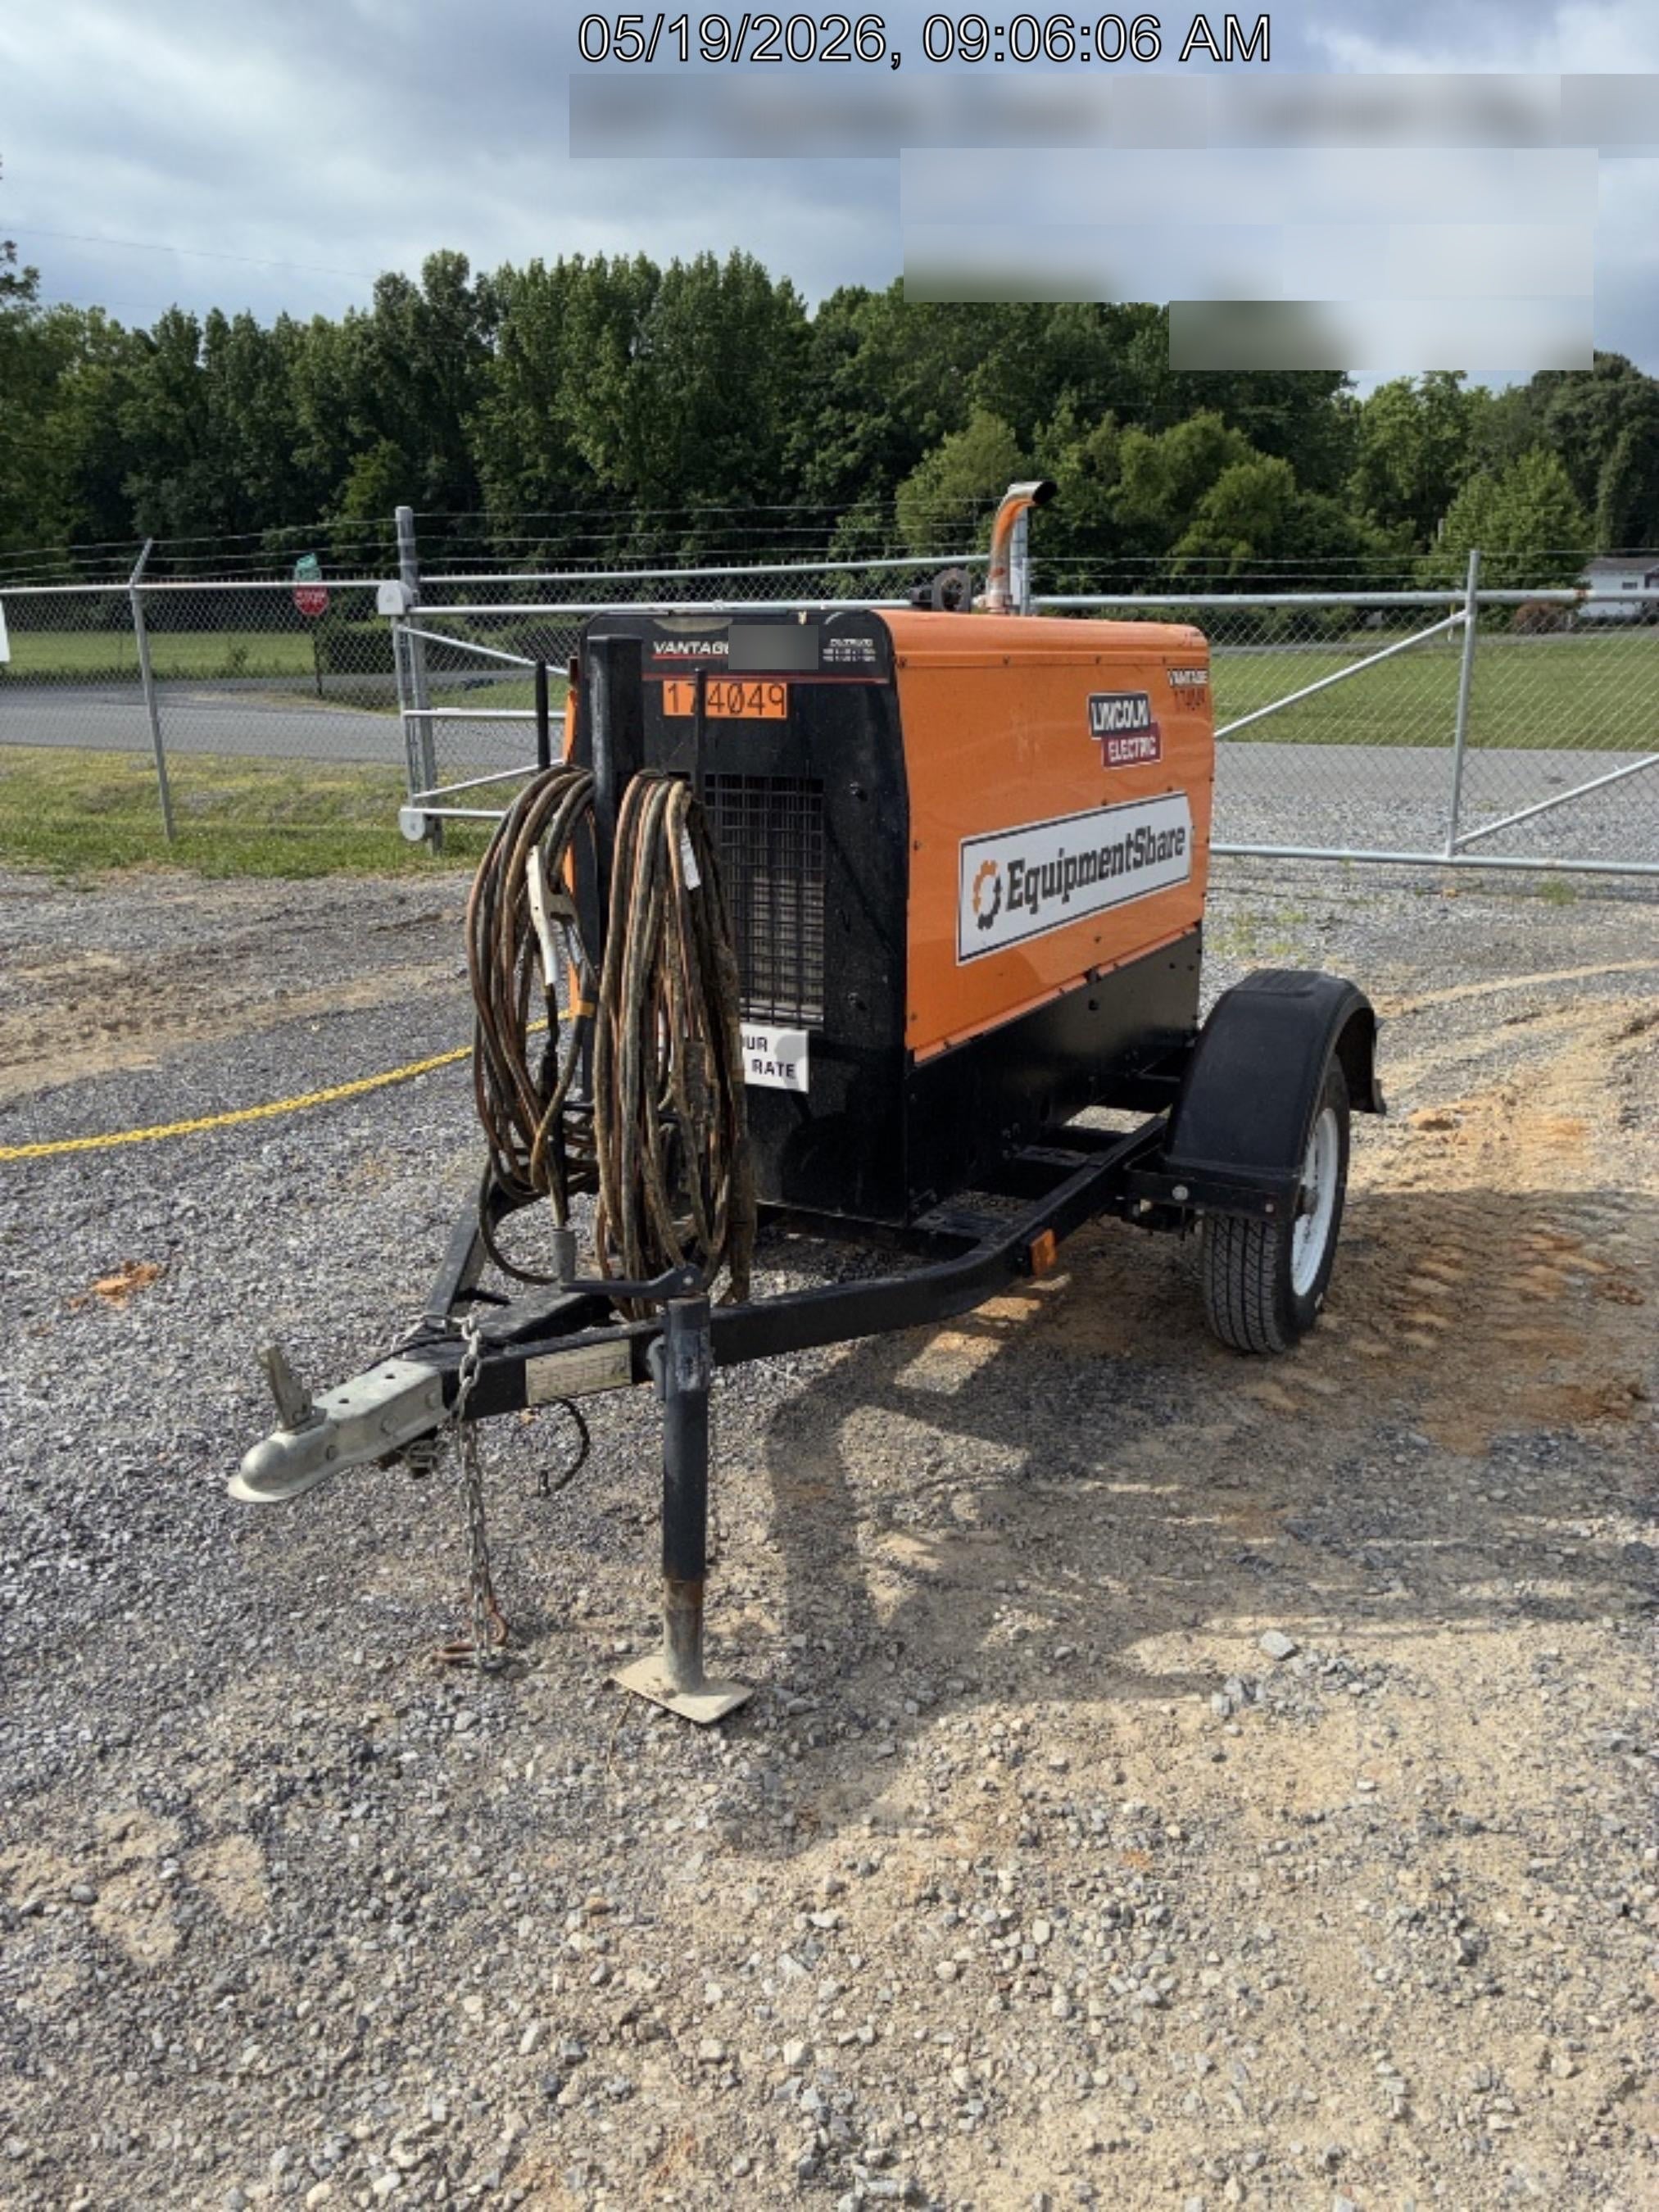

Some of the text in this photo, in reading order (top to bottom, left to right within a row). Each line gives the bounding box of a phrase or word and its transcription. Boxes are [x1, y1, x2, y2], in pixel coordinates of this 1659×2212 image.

[1090, 699, 1149, 731] LINCOLN
[1108, 736, 1156, 763] ELECTRIC
[1004, 824, 1186, 915] EquipmentShare
[751, 1058, 796, 1079] RATE
